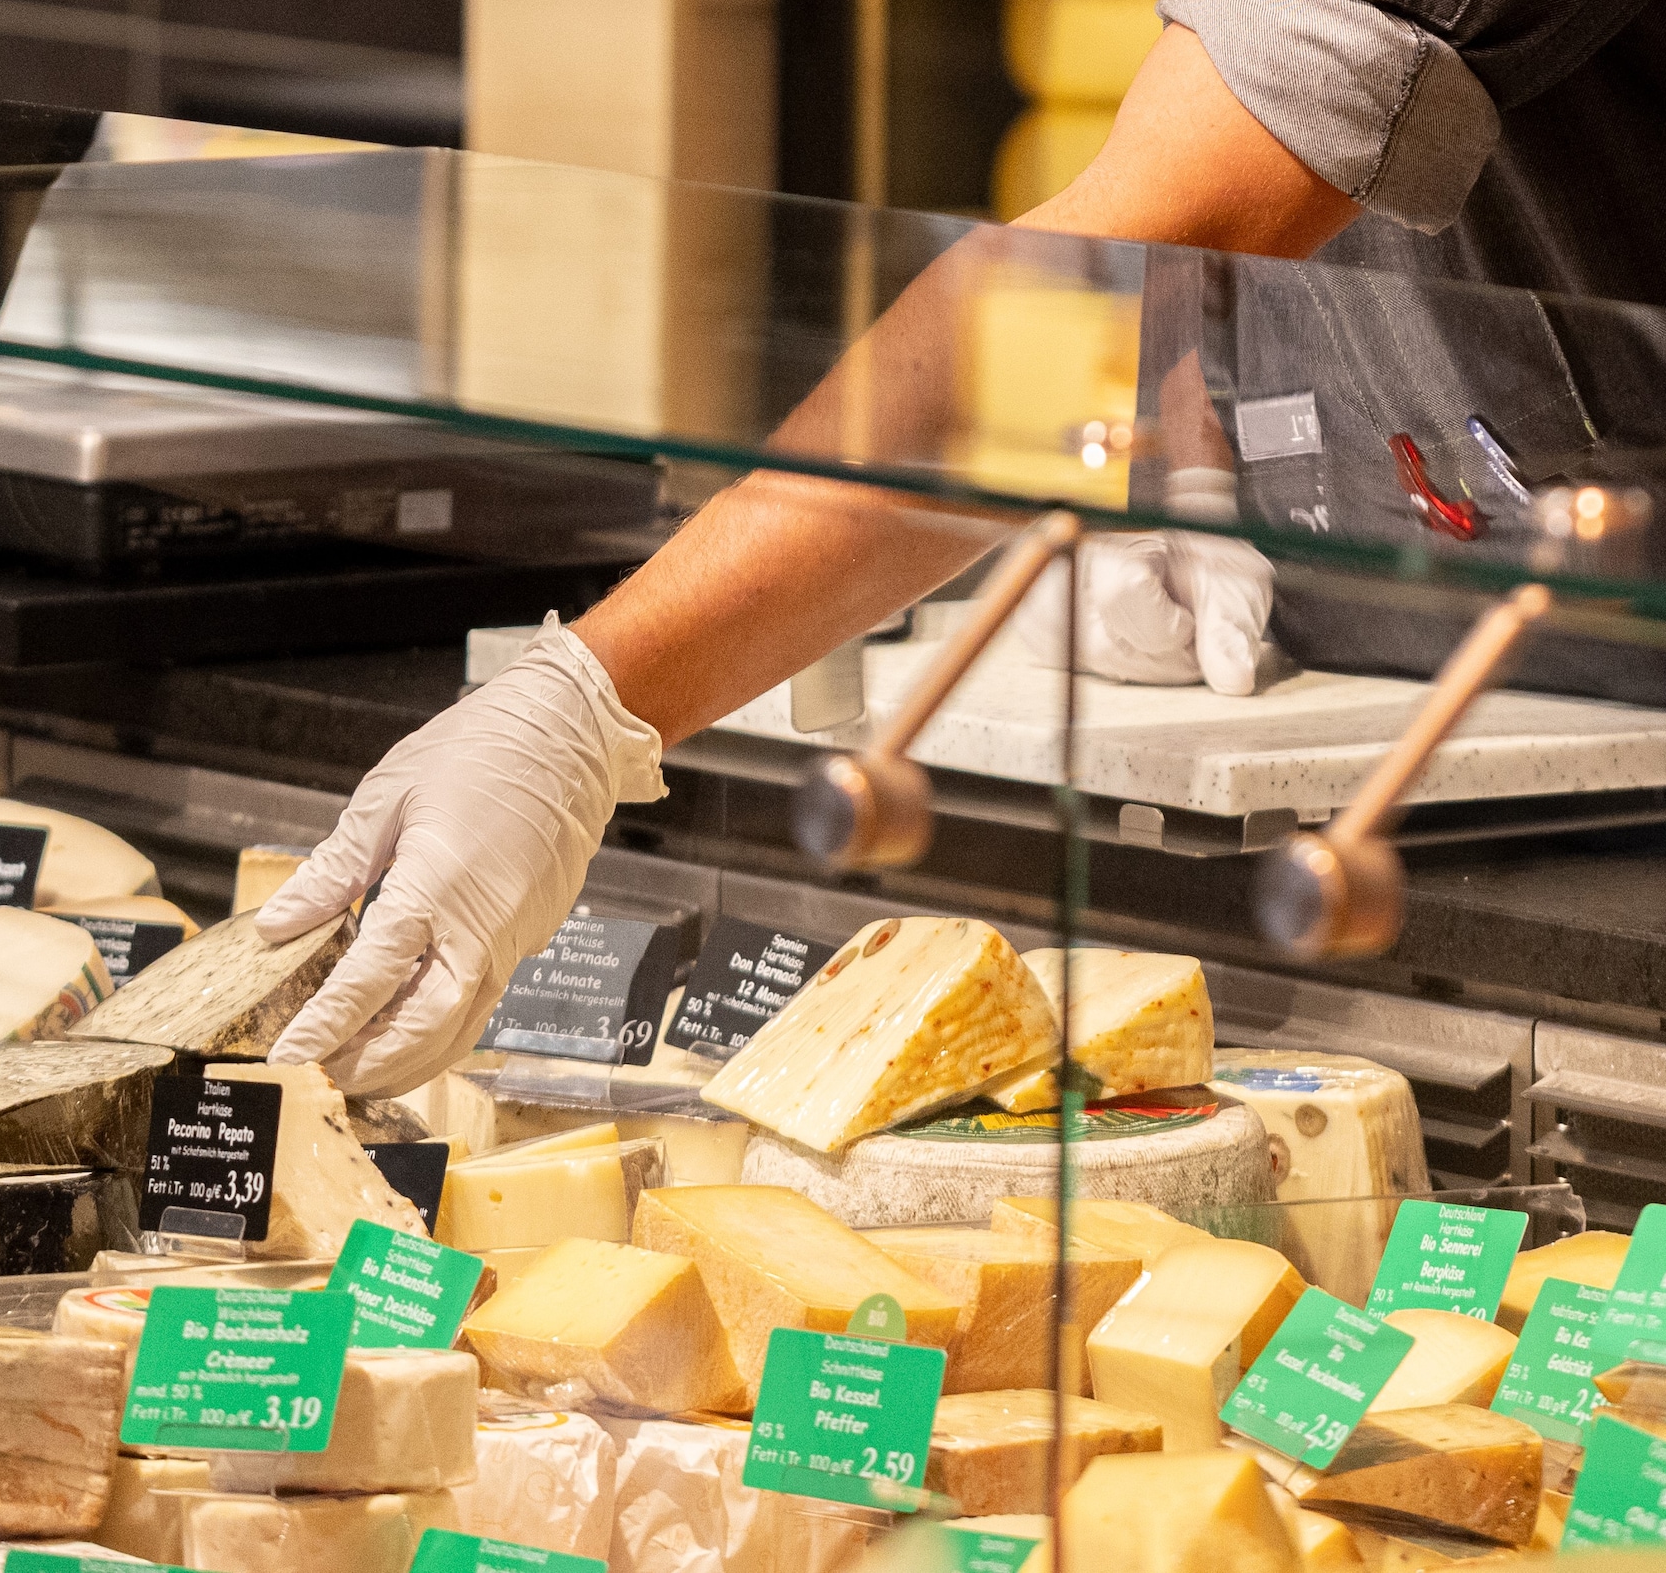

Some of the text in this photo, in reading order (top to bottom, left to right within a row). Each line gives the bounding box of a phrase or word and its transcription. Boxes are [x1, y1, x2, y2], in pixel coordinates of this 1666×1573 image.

[772, 933, 808, 955] Spanien
[562, 947, 620, 967] Bernado
[762, 947, 805, 970] Hartkäse
[533, 968, 602, 989] 6 Monate
[729, 952, 802, 986] Don Bernado
[512, 985, 626, 1007] Schafsmilch hergestellt
[738, 979, 755, 996] 12
[687, 997, 713, 1017] 50 %
[721, 994, 766, 1016] Schafsmilch
[677, 1017, 702, 1033] Fett
[204, 1080, 231, 1096] Italien
[197, 1101, 233, 1117] Hartkäse
[168, 1118, 255, 1147] Pecorino Pepato
[151, 1155, 170, 1171] 51 %
[171, 1146, 249, 1163] mit Schafsmilch hergestellt
[147, 1170, 265, 1209] Fett 100 g/€ 3,39
[1439, 1204, 1487, 1223] Deutschland
[1439, 1222, 1475, 1238] Hartkäse
[1420, 1233, 1484, 1257] Bio Sennerei
[361, 1257, 443, 1300] Bio Backensholz
[1420, 1260, 1466, 1283] Bergkäse
[1373, 1288, 1394, 1303] 50 %
[383, 1294, 437, 1327] Deichkäse
[183, 1320, 310, 1344] Bio Backensholz
[809, 1379, 831, 1401] Bio
[259, 1395, 322, 1434] 3,19
[814, 1410, 870, 1435] Pfeffer
[756, 1422, 785, 1440] 45 %
[1303, 1414, 1349, 1451] 2,59
[751, 1445, 778, 1463] Fett
[859, 1446, 915, 1484] 2,59
